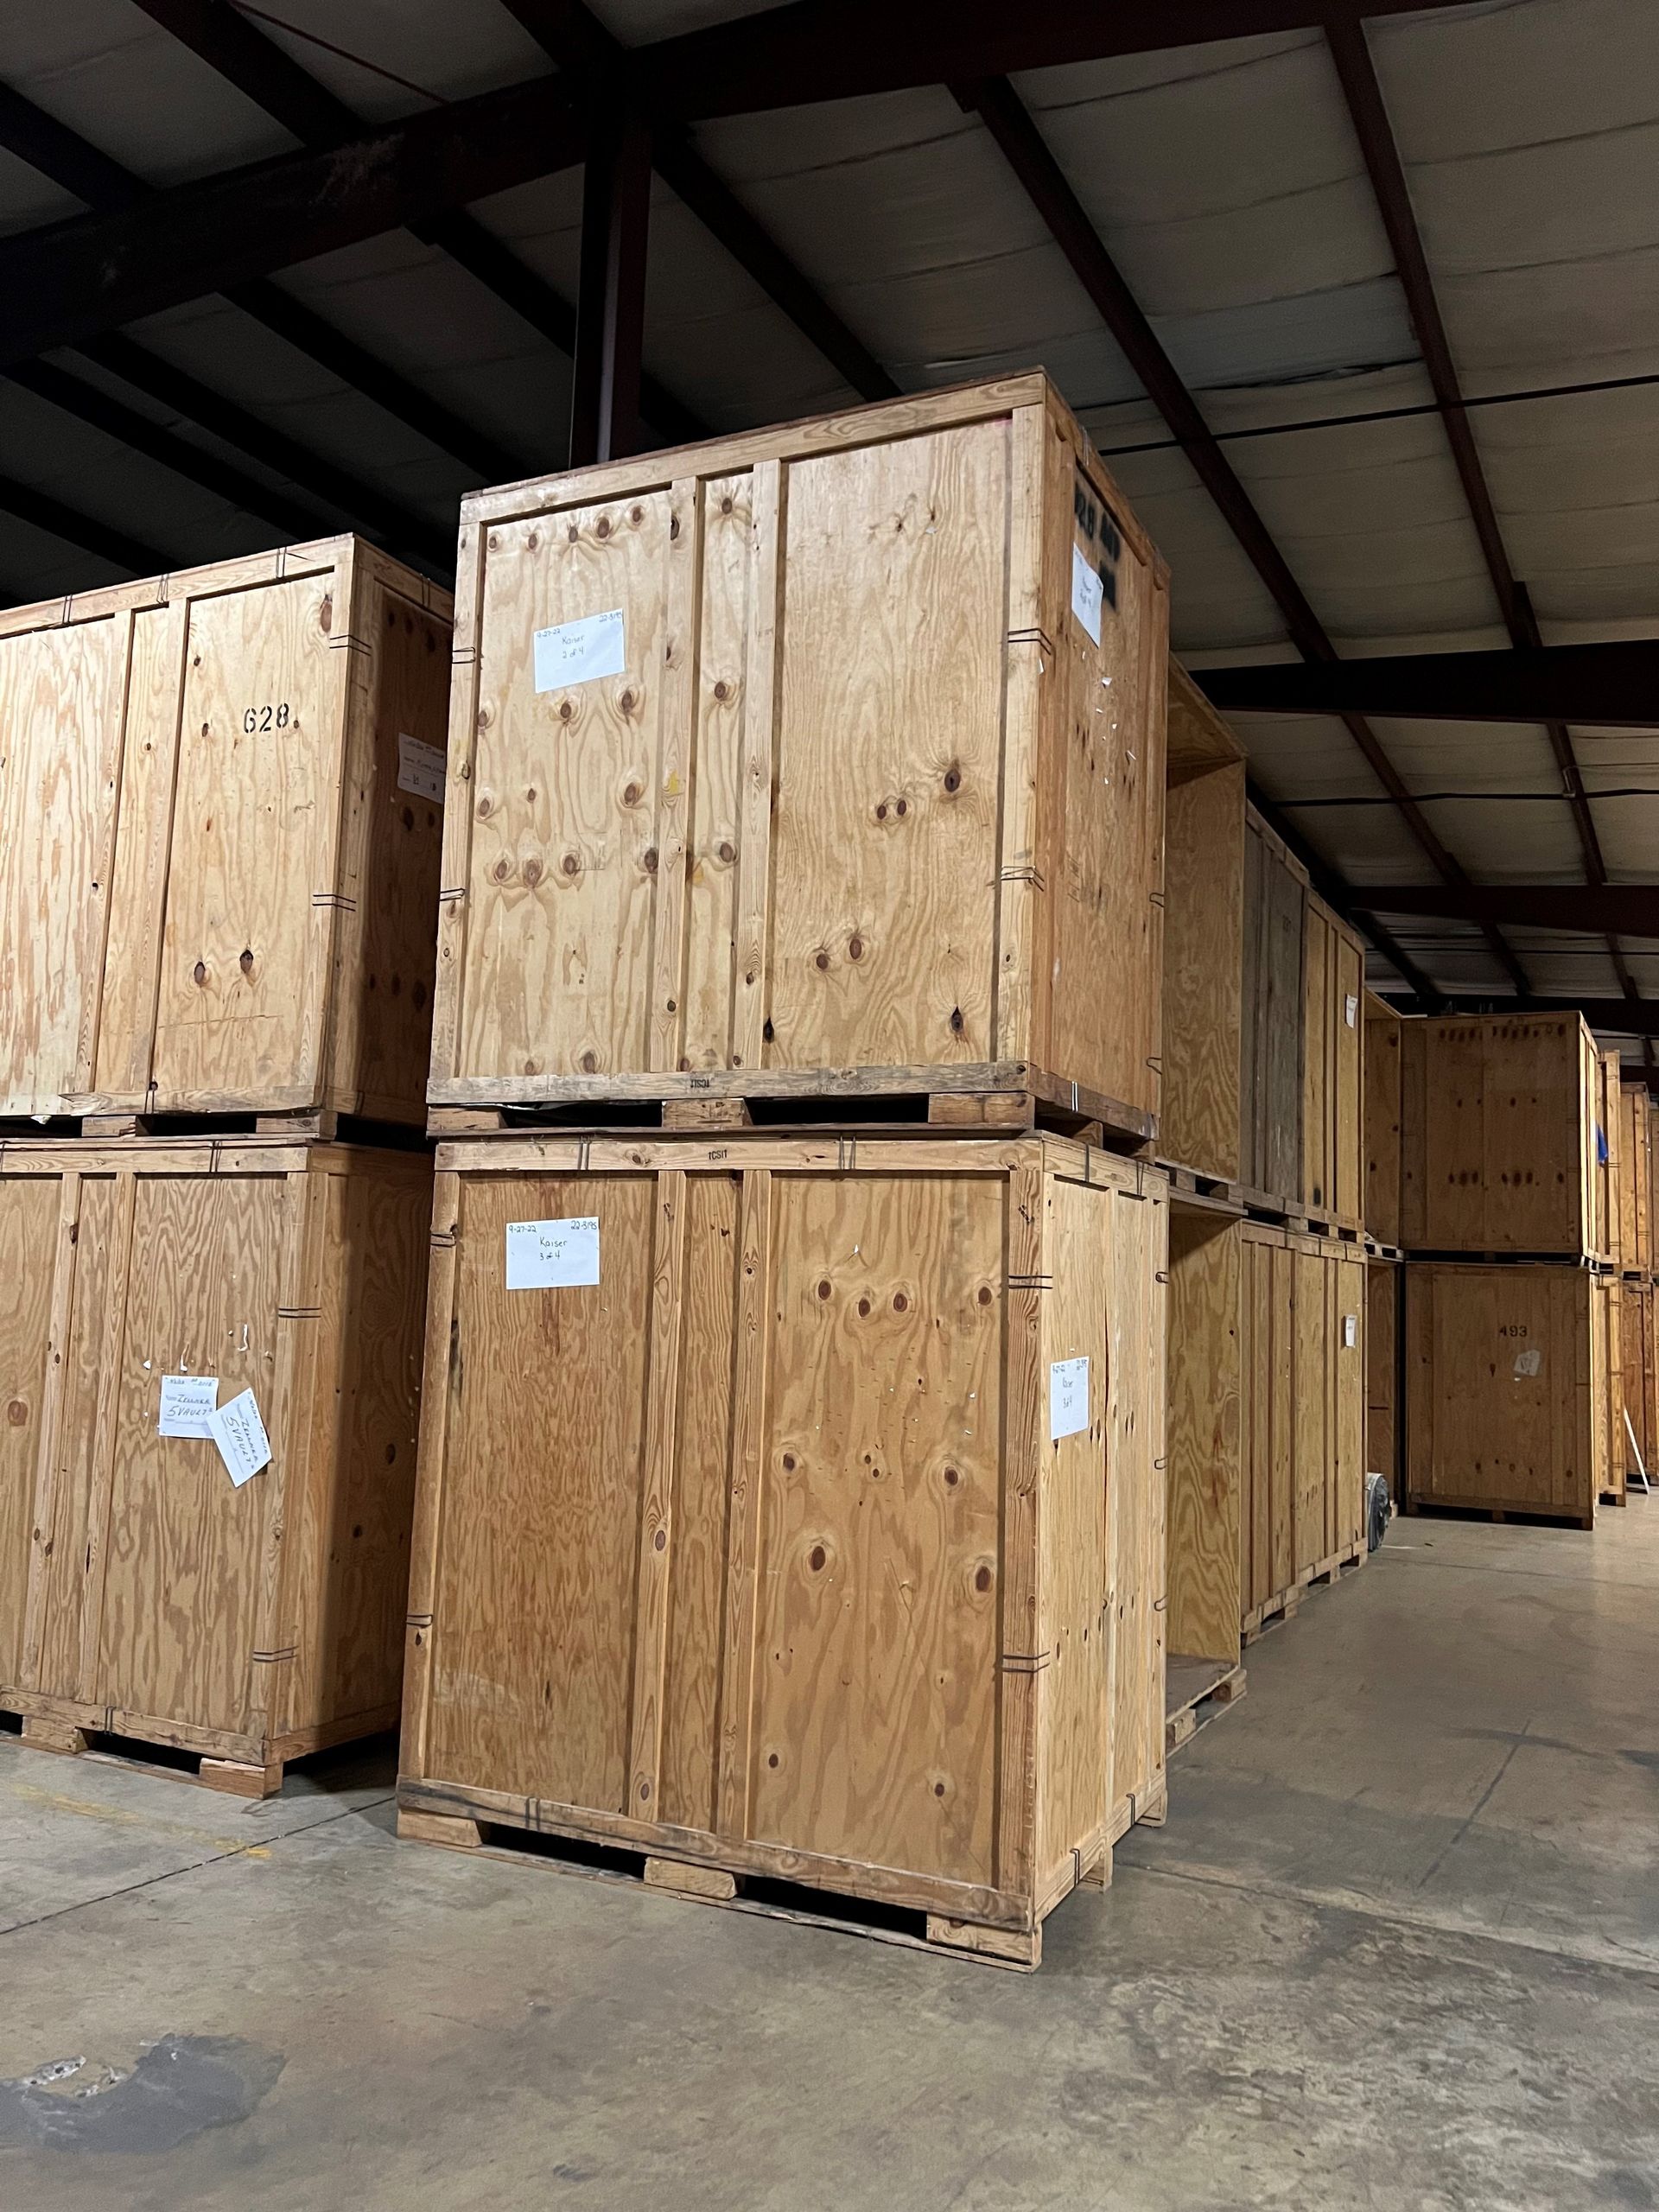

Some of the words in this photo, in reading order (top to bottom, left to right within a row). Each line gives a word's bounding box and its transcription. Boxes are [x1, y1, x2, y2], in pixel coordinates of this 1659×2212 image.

[563, 651, 567, 659] 2
[579, 646, 584, 655] 4
[244, 702, 289, 734] 628
[508, 1224, 537, 1233] 9-27-22
[539, 1236, 567, 1248] Kaiser
[539, 1252, 544, 1261] 3
[555, 1249, 560, 1260] 4
[1499, 1325, 1528, 1337] 493
